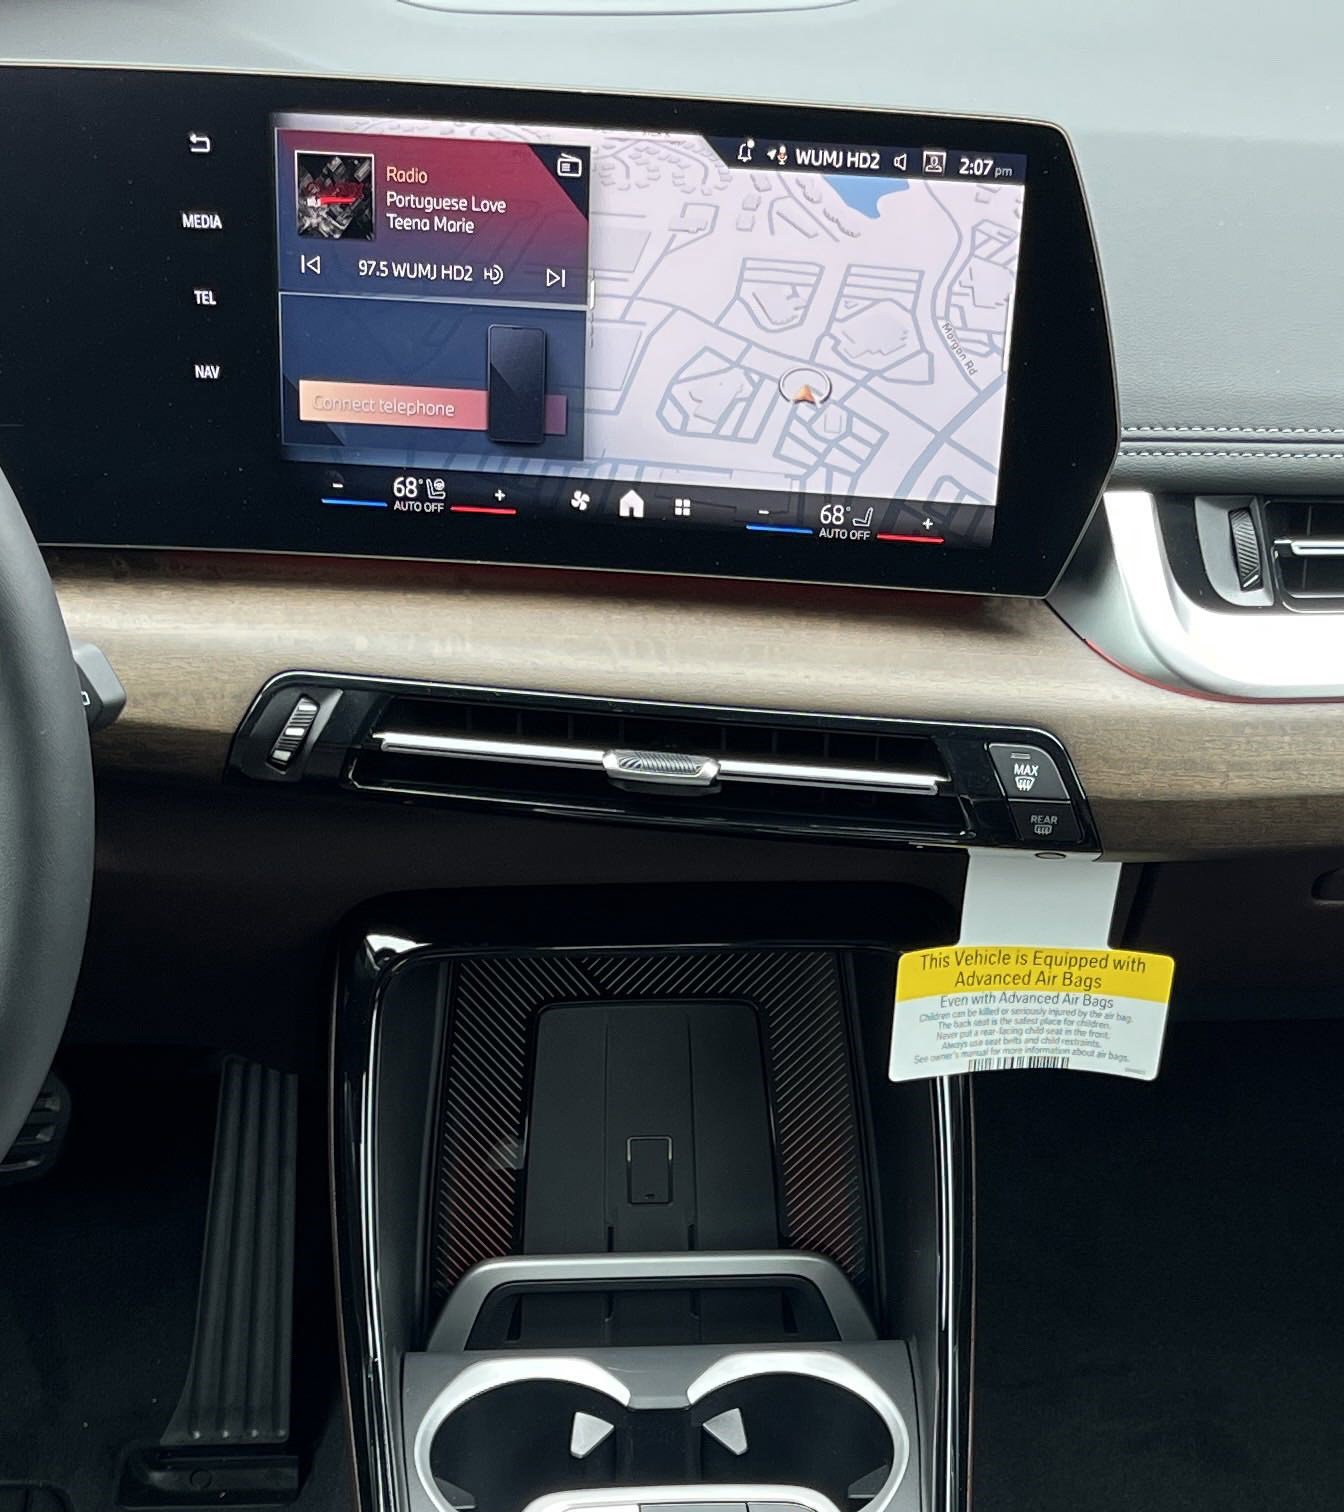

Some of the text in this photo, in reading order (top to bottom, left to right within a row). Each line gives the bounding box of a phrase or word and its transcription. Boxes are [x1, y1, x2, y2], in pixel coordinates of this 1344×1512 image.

[795, 149, 880, 169] WUMJ HD2
[959, 157, 1013, 178] 2:07 pm
[386, 166, 428, 184] Radio
[386, 191, 507, 215] Portuguese Love
[182, 213, 223, 229] MEDIA
[386, 213, 475, 234] Teena Marie
[359, 260, 389, 278] 97.5
[391, 262, 438, 280] WUMJ
[441, 264, 473, 282] HD2
[194, 290, 217, 305] TEL
[941, 322, 978, 377] Morgan Rd
[194, 365, 220, 379] NAV
[312, 395, 455, 418] Connect telephone
[394, 500, 445, 514] AUTO OFF
[819, 528, 871, 541] AUTO OFF
[1013, 763, 1039, 777] MAX
[1030, 815, 1058, 825] REAR
[920, 949, 1146, 974] This Vehicle is Equipped with
[955, 970, 1102, 992] Advanced Air Bags
[940, 992, 1115, 1010] Even with Advanced Air Bags
